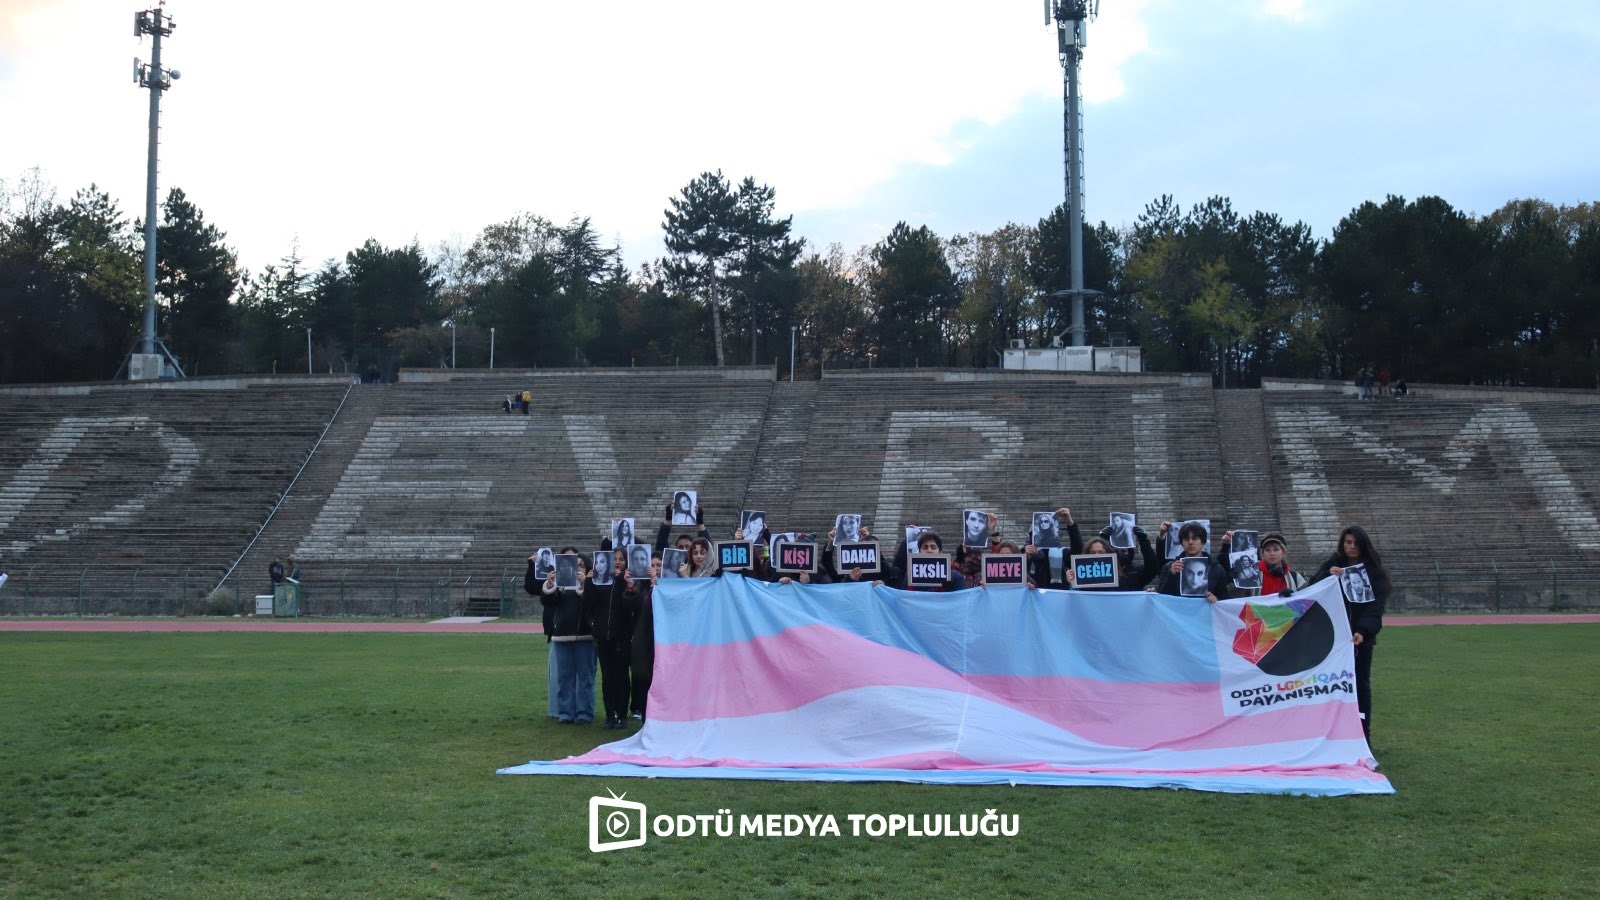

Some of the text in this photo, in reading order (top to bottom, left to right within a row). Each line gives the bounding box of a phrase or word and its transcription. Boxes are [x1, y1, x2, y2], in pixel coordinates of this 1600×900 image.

[721, 544, 748, 565] BİR
[783, 548, 811, 567] KİŞİ
[842, 548, 876, 564] DAHA
[912, 561, 947, 580] EKSİL
[986, 562, 1022, 579] MEYE
[1076, 561, 1113, 580] CEĞİZ
[1231, 683, 1273, 700] ODTÜ
[1239, 681, 1354, 708] DAYANIŞMASI
